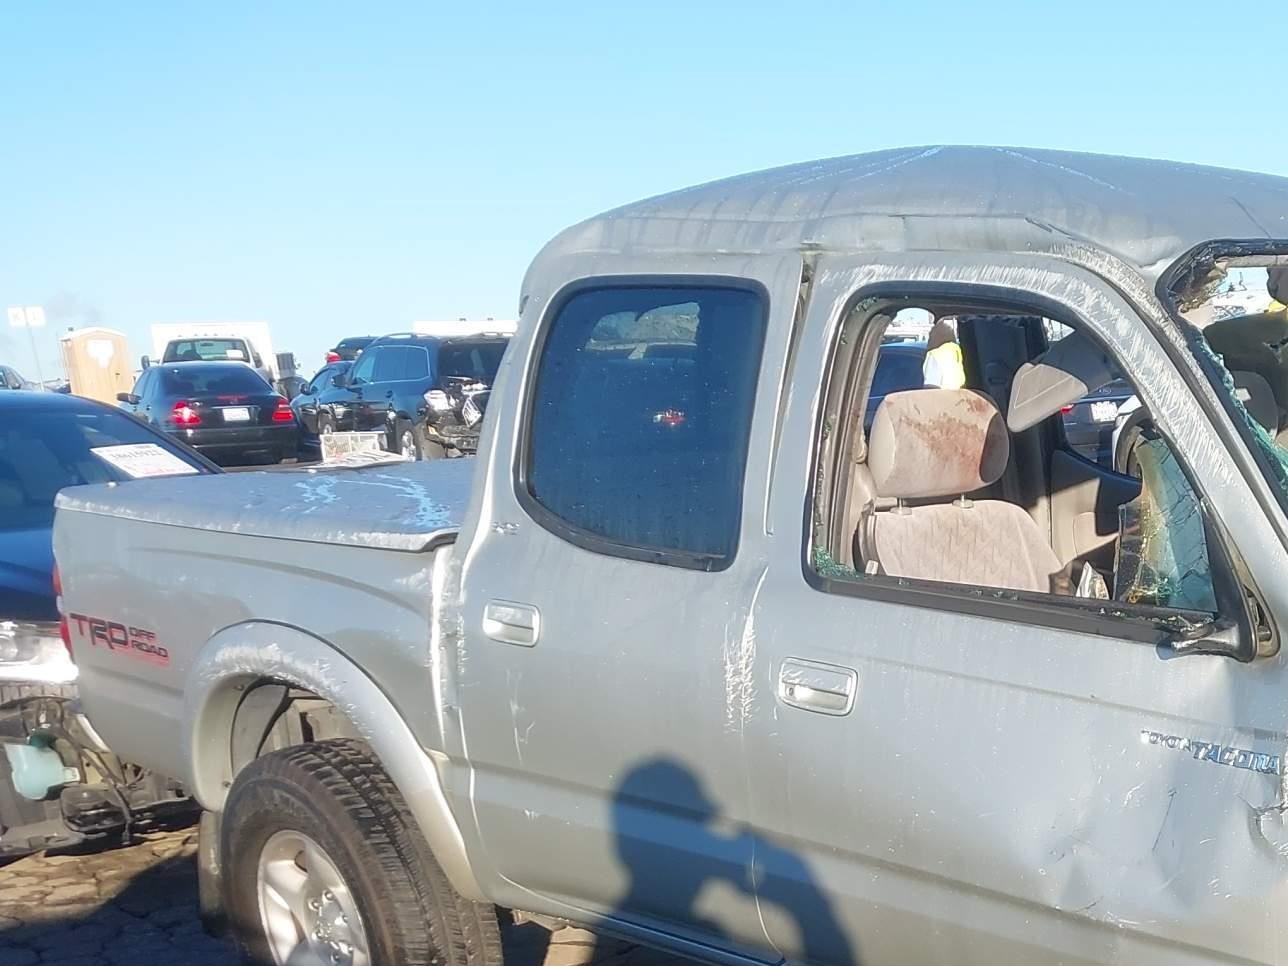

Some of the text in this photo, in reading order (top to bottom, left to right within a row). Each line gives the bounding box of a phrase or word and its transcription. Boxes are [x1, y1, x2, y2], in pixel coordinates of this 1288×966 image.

[69, 612, 128, 650] TRD
[128, 627, 156, 639] OFF
[131, 640, 169, 657] ROAD
